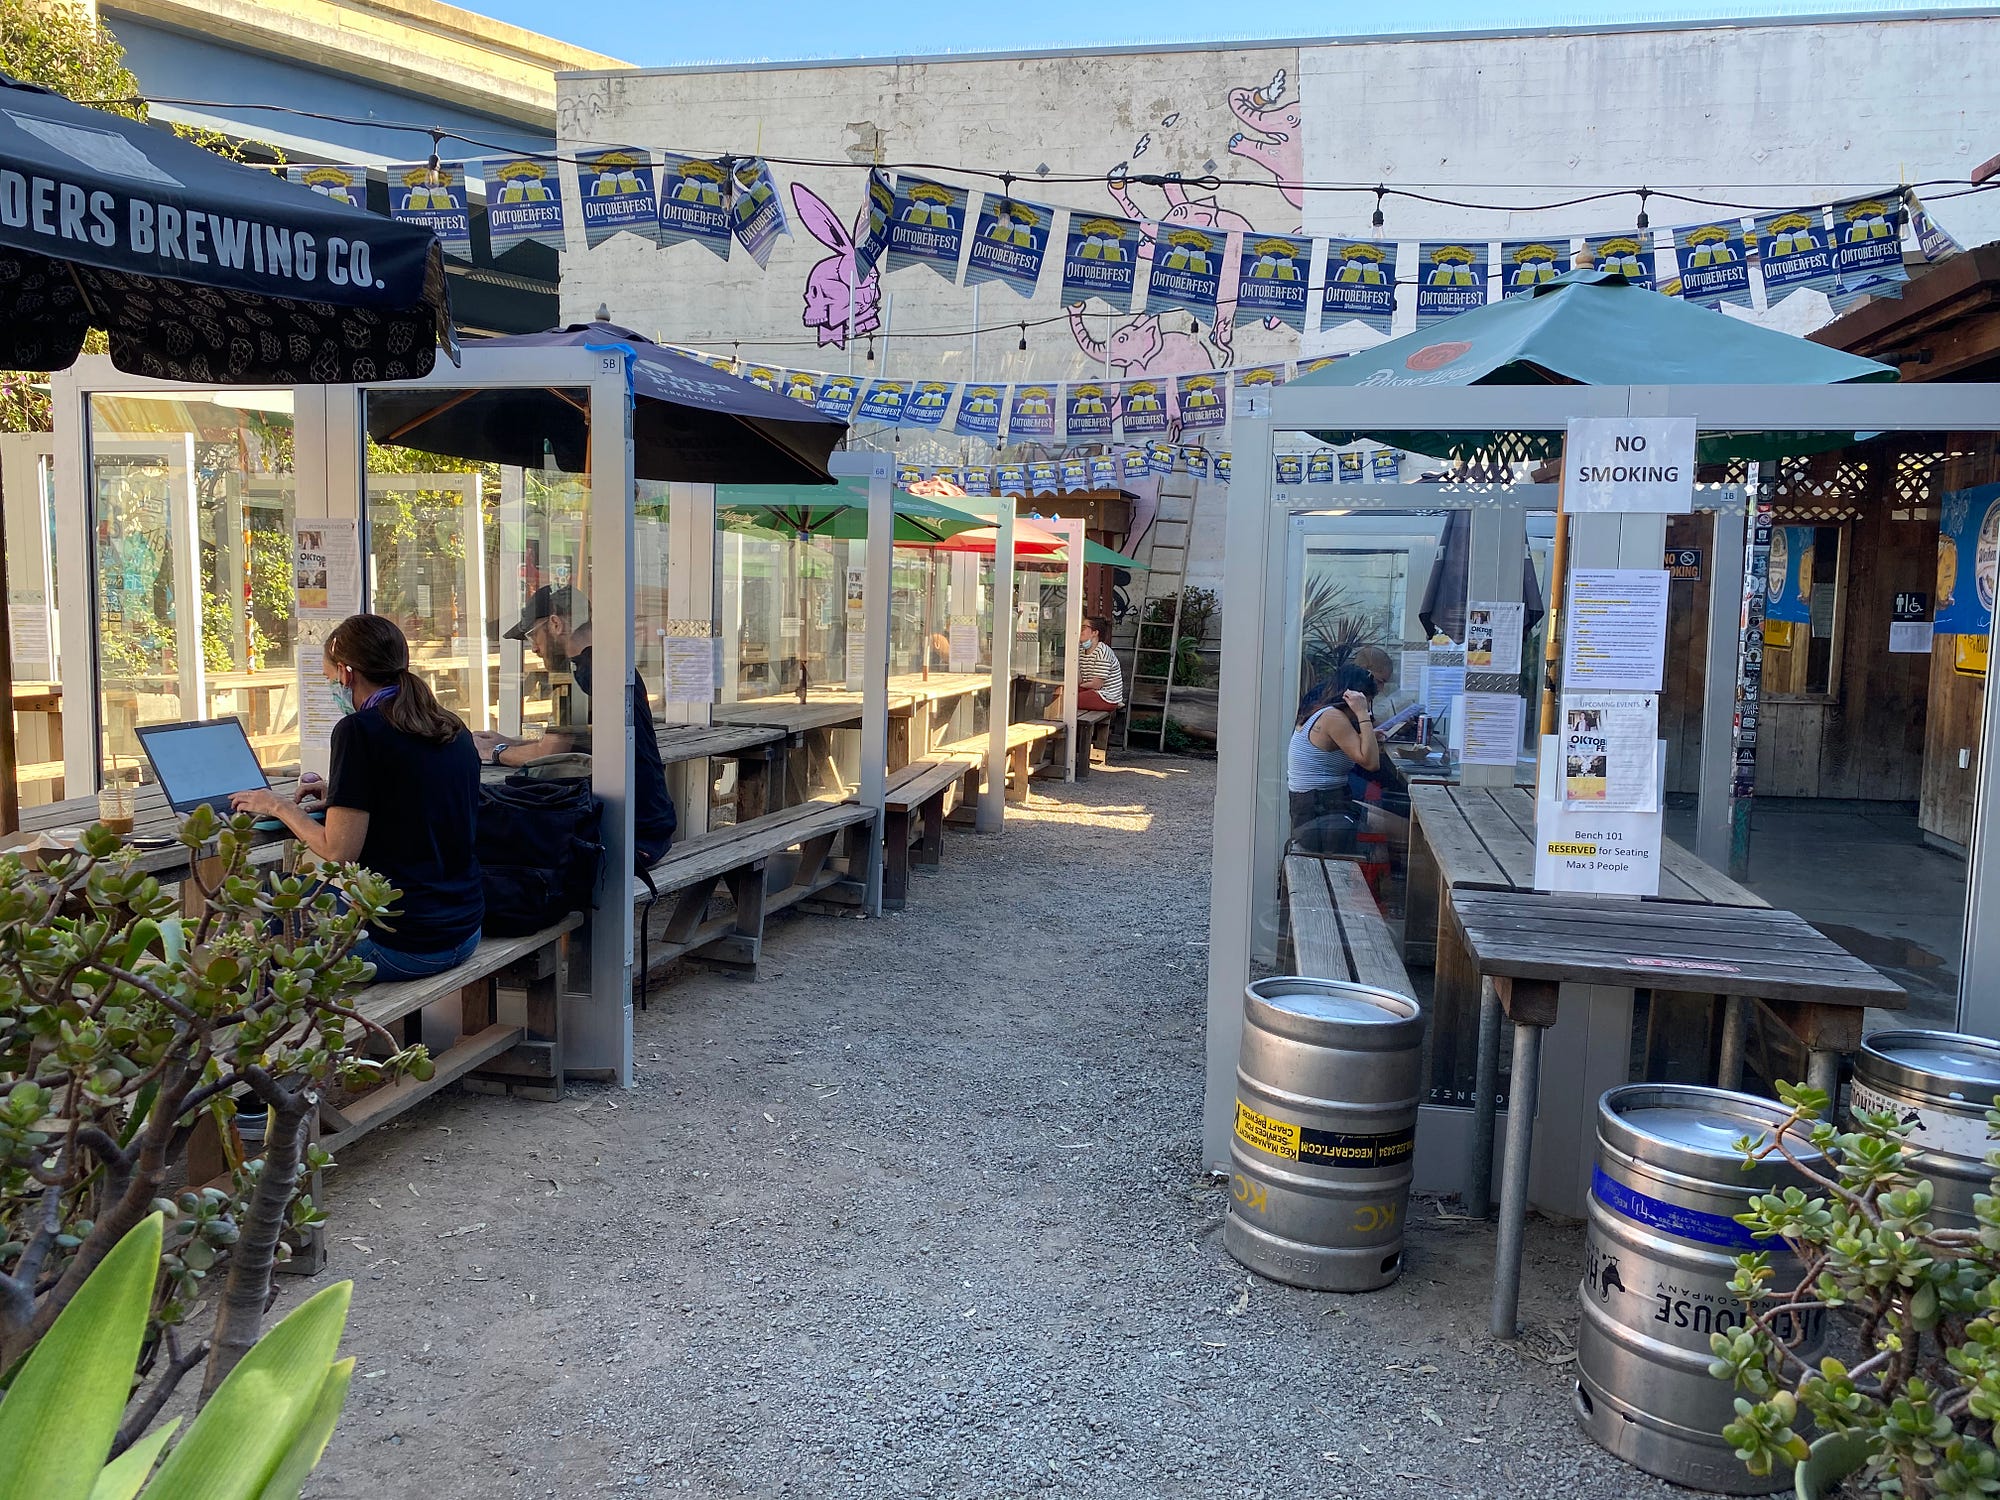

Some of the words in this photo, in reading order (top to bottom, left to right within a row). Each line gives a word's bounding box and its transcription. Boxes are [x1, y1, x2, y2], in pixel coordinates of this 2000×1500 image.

[492, 205, 561, 226] OKTOBERFEST
[585, 197, 655, 219] OKTOBERFEST
[663, 203, 731, 230] OKTOBERFEST
[1, 170, 117, 248] DERS
[129, 199, 317, 282] BREWING
[327, 236, 386, 289] CO.
[892, 225, 958, 251] OKTOBERFEST
[974, 241, 1039, 271] OKTOBERFEST
[1840, 241, 1900, 264] OKTOBERFEST
[1066, 261, 1132, 284] OKTOBERFEST
[1764, 253, 1829, 279] OKTOBERFEST
[1152, 271, 1216, 296] OKTOBERFEST
[1683, 267, 1746, 290] OKTOBERFEST
[1240, 282, 1305, 303] OKTOBERFEST
[1326, 286, 1391, 306] OKTOBERFEST
[1420, 290, 1484, 306] OKTOBERFEST
[602, 358, 616, 369] 5B
[1615, 435, 1647, 452] NO
[1578, 466, 1679, 482] SMOKING
[1668, 566, 1698, 577] OKING
[1580, 699, 1616, 708] UPCOMING
[1616, 700, 1640, 708] EVENTS
[1574, 830, 1603, 840] Bench
[1606, 832, 1623, 841] 101
[1548, 844, 1596, 854] RESERVED
[1599, 846, 1612, 855] for
[1614, 847, 1649, 858] Seating
[1566, 860, 1586, 869] Max
[1588, 861, 1594, 870] 3
[1597, 862, 1629, 872] People
[1242, 1109, 1267, 1129] BREWERS
[1255, 1126, 1288, 1145] SERVICES
[1268, 1123, 1294, 1137] CRAFT
[1280, 1146, 1297, 1159] KEG
[1300, 1141, 1373, 1159] KEGCRAFT.COM
[1233, 1174, 1268, 1214] KC
[1353, 1202, 1397, 1232] KC
[1657, 1281, 1740, 1307] COMPANY
